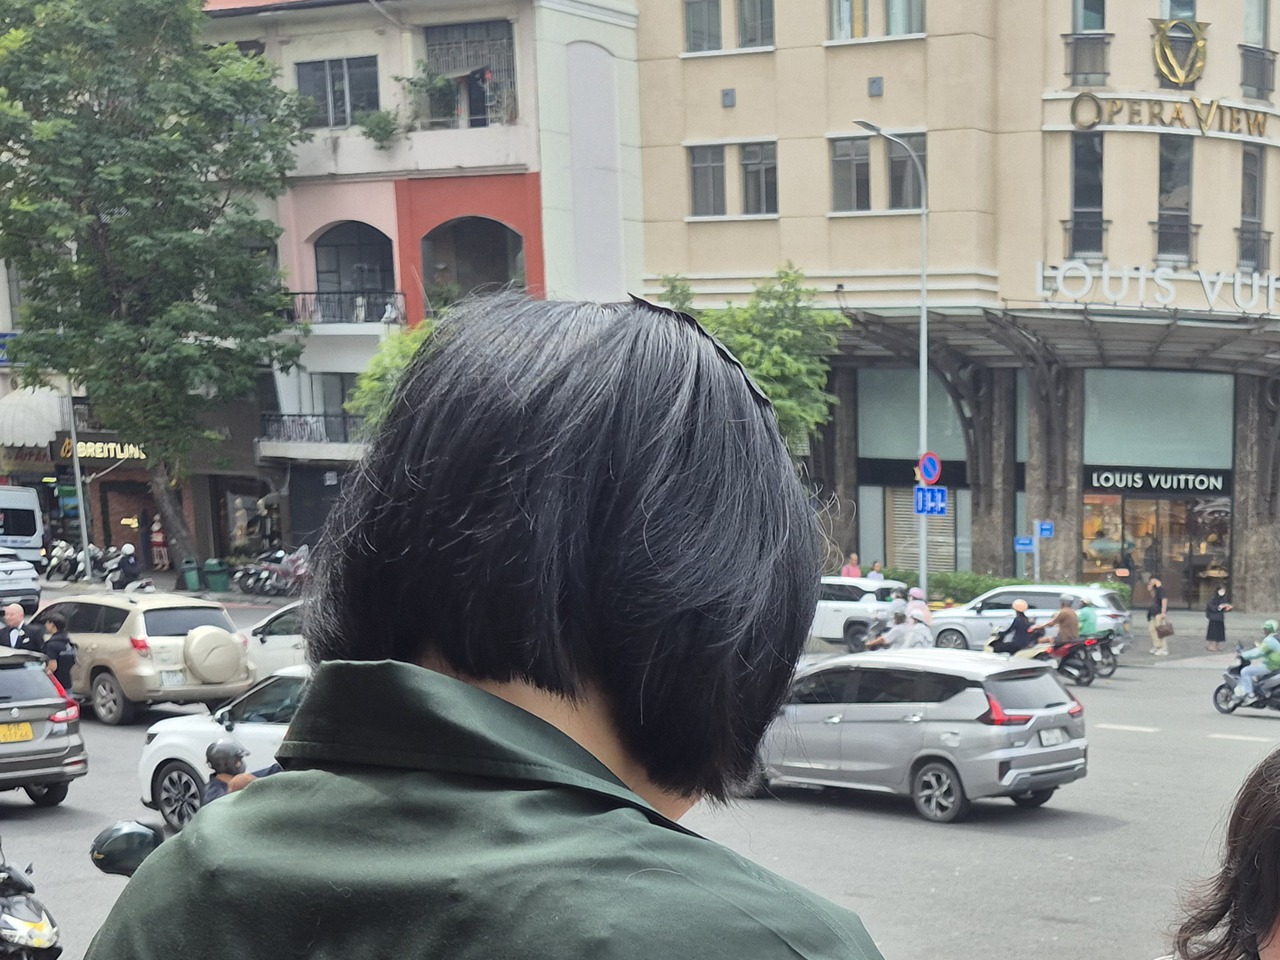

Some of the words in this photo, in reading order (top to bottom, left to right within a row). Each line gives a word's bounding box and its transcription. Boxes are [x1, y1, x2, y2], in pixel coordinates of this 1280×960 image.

[1035, 259, 1177, 305] LOUIS
[1092, 471, 1144, 488] LOUIS
[1148, 473, 1223, 491] VUITTON
